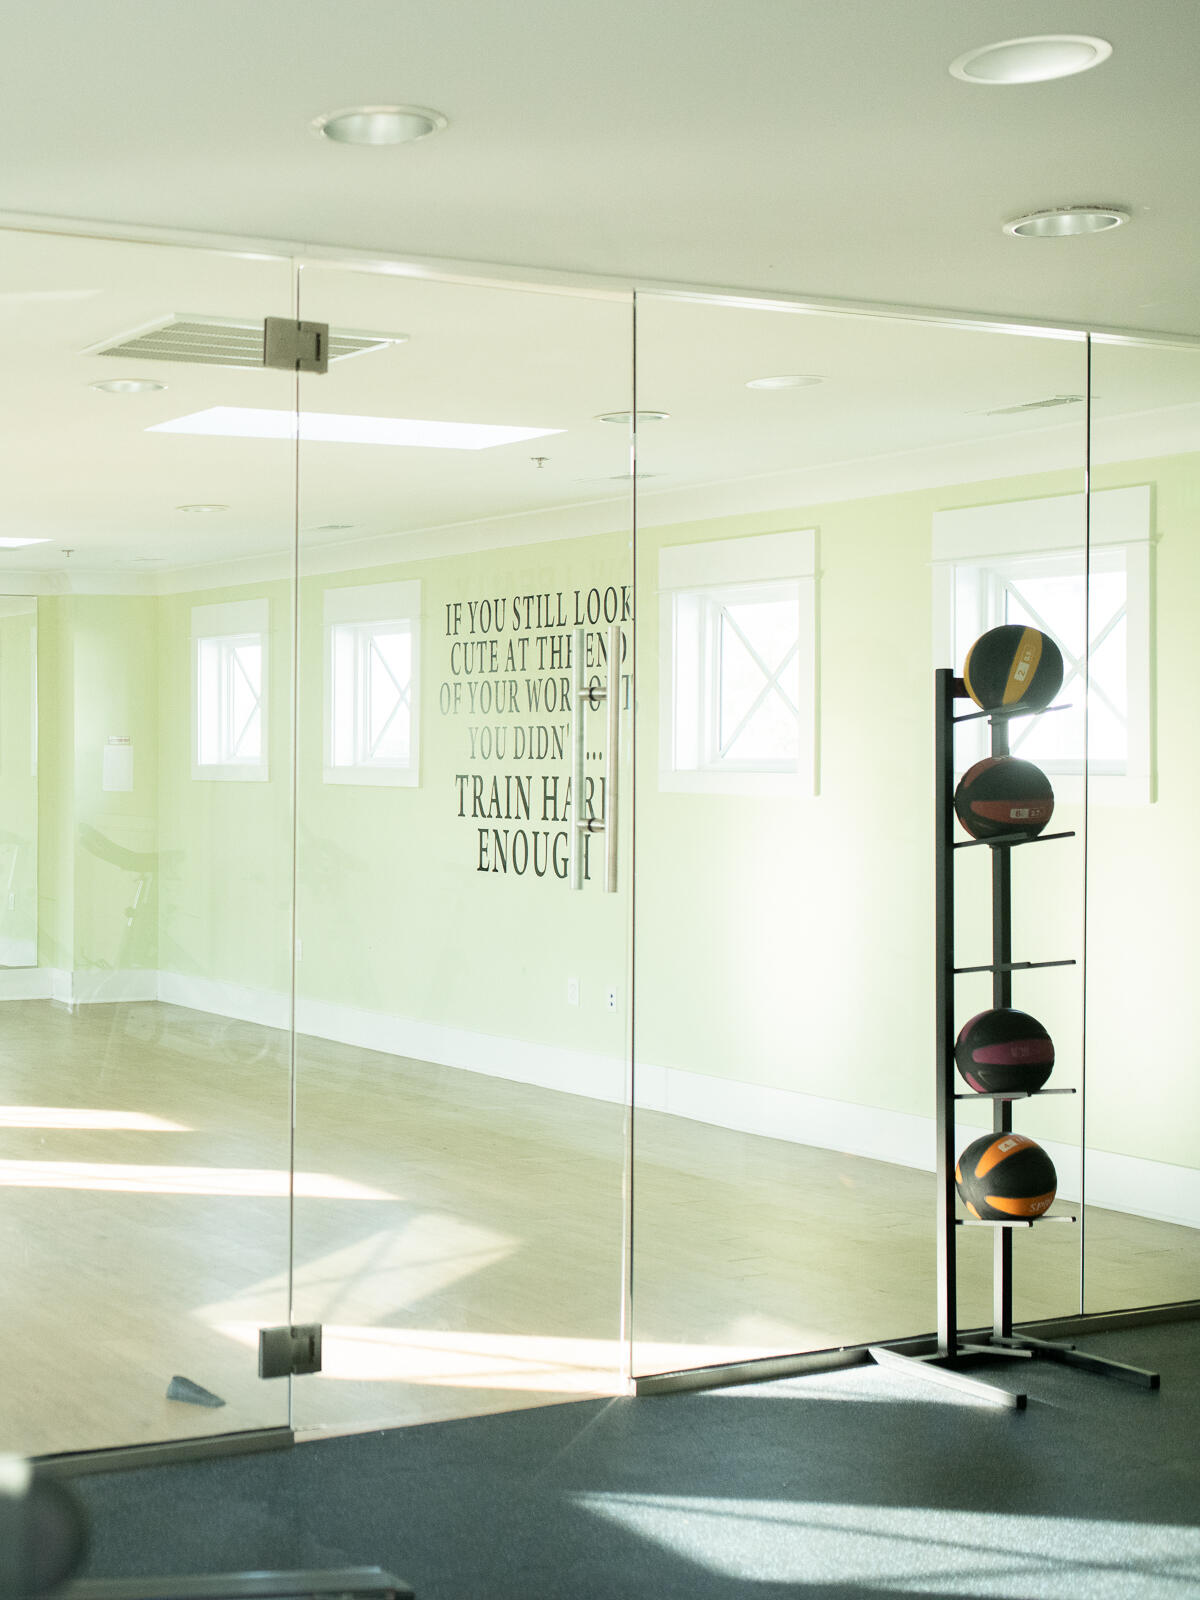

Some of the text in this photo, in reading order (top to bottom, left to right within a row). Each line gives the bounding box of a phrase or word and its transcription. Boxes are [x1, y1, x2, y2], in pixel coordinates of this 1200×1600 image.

[445, 585, 634, 636] IF YOU STILL LOOK
[450, 640, 499, 675] CUTE
[504, 638, 530, 672] AT
[439, 674, 633, 716] OF YOUR WOROT
[467, 726, 507, 760] YOU
[455, 774, 532, 820] TRAIN
